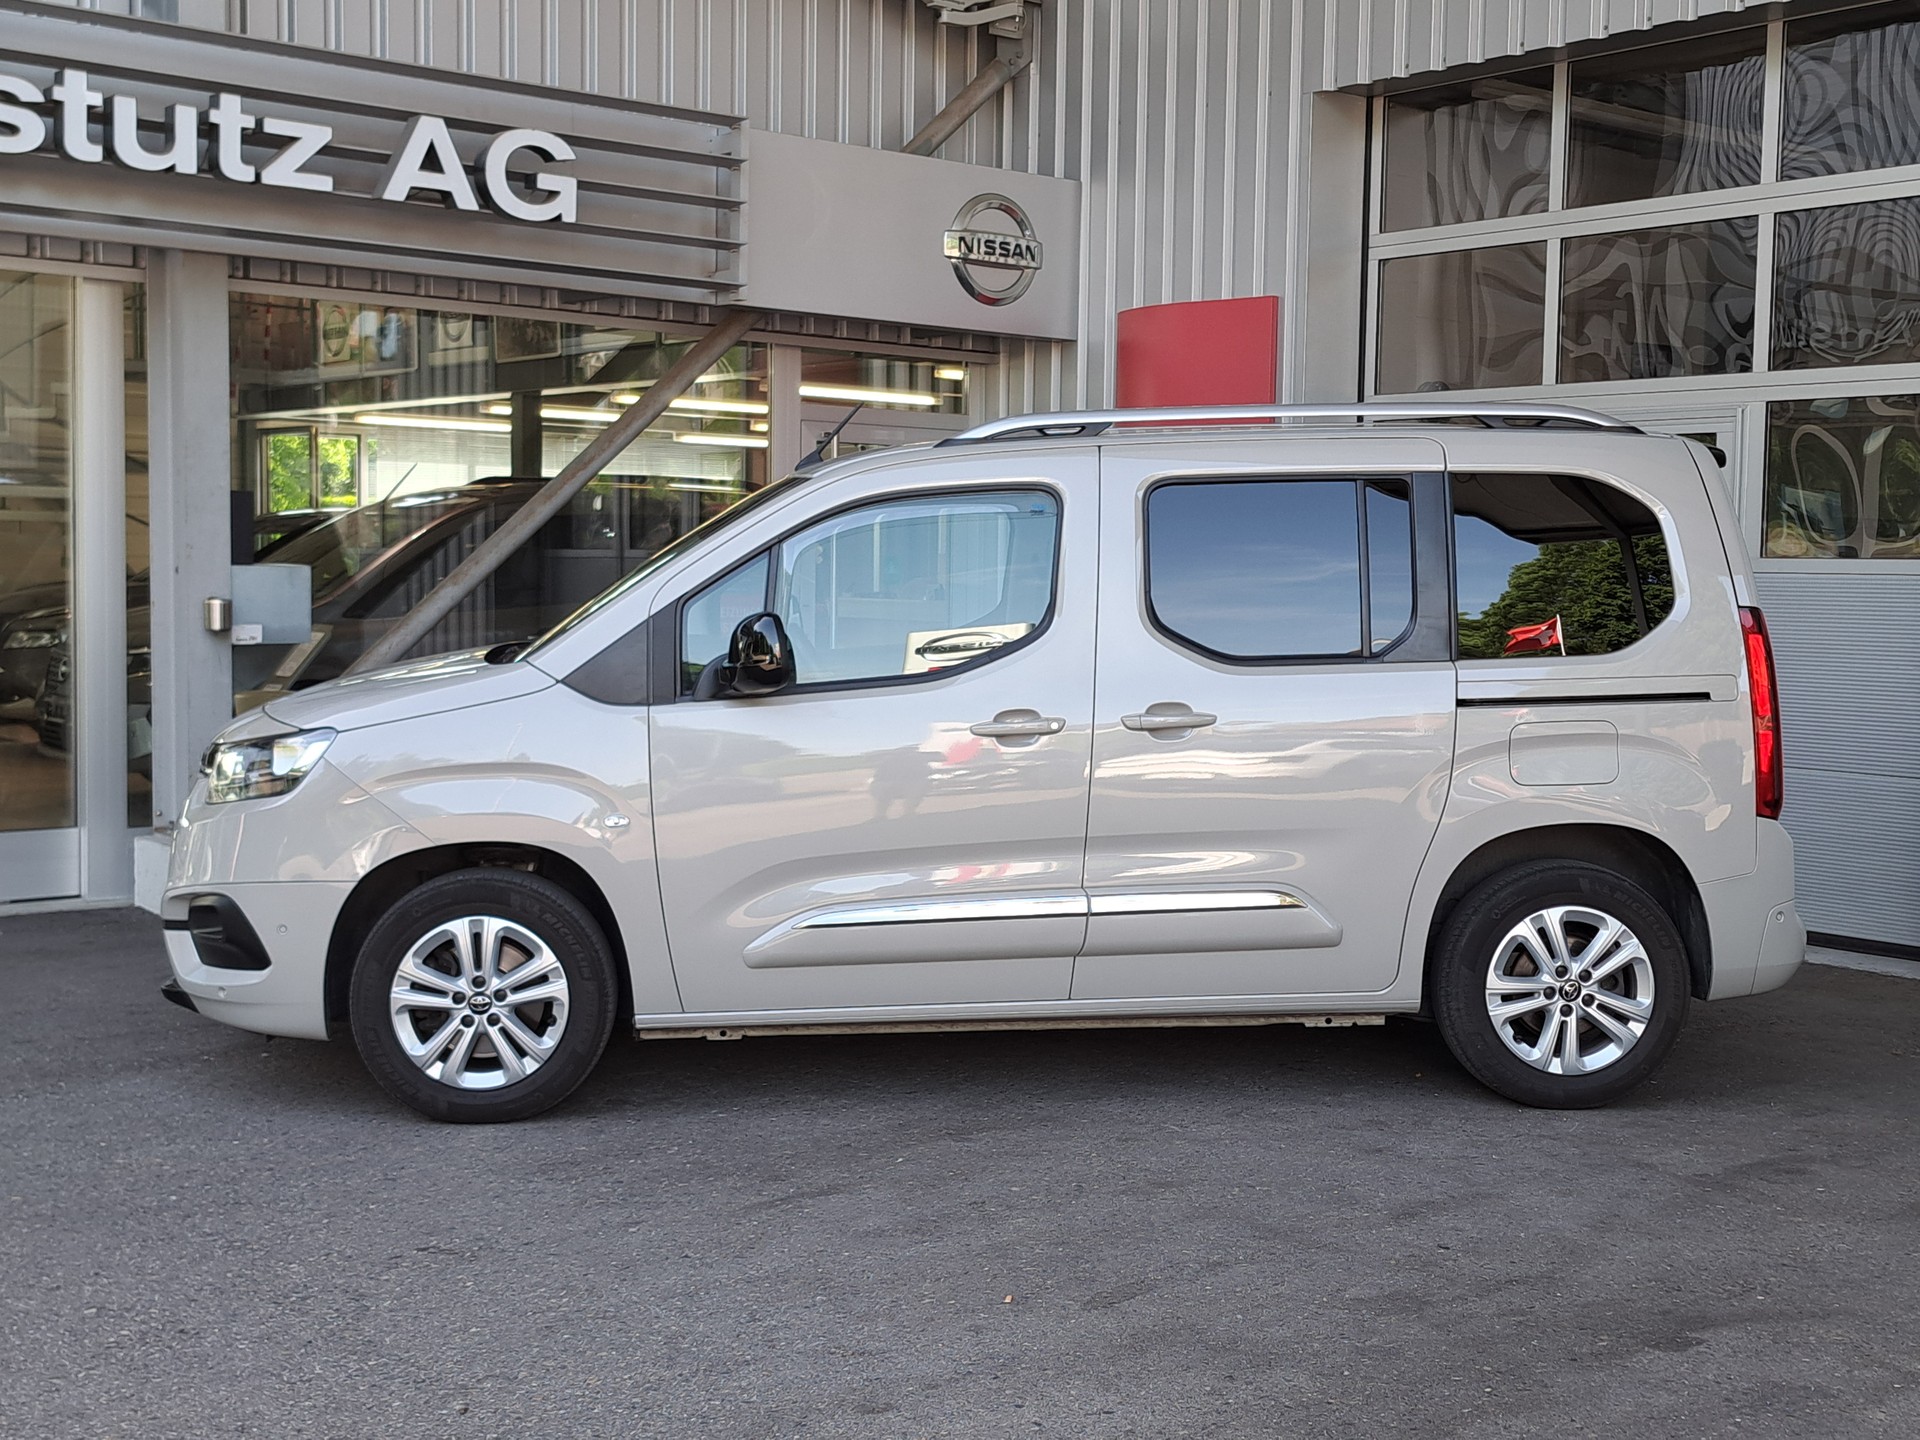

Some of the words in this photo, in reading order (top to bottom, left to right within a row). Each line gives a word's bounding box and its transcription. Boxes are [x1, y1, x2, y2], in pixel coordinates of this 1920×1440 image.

[382, 115, 577, 223] AG
[958, 236, 1038, 262] NISSAN
[541, 912, 592, 981] MICHELIN
[1613, 891, 1671, 949] MICHELIN
